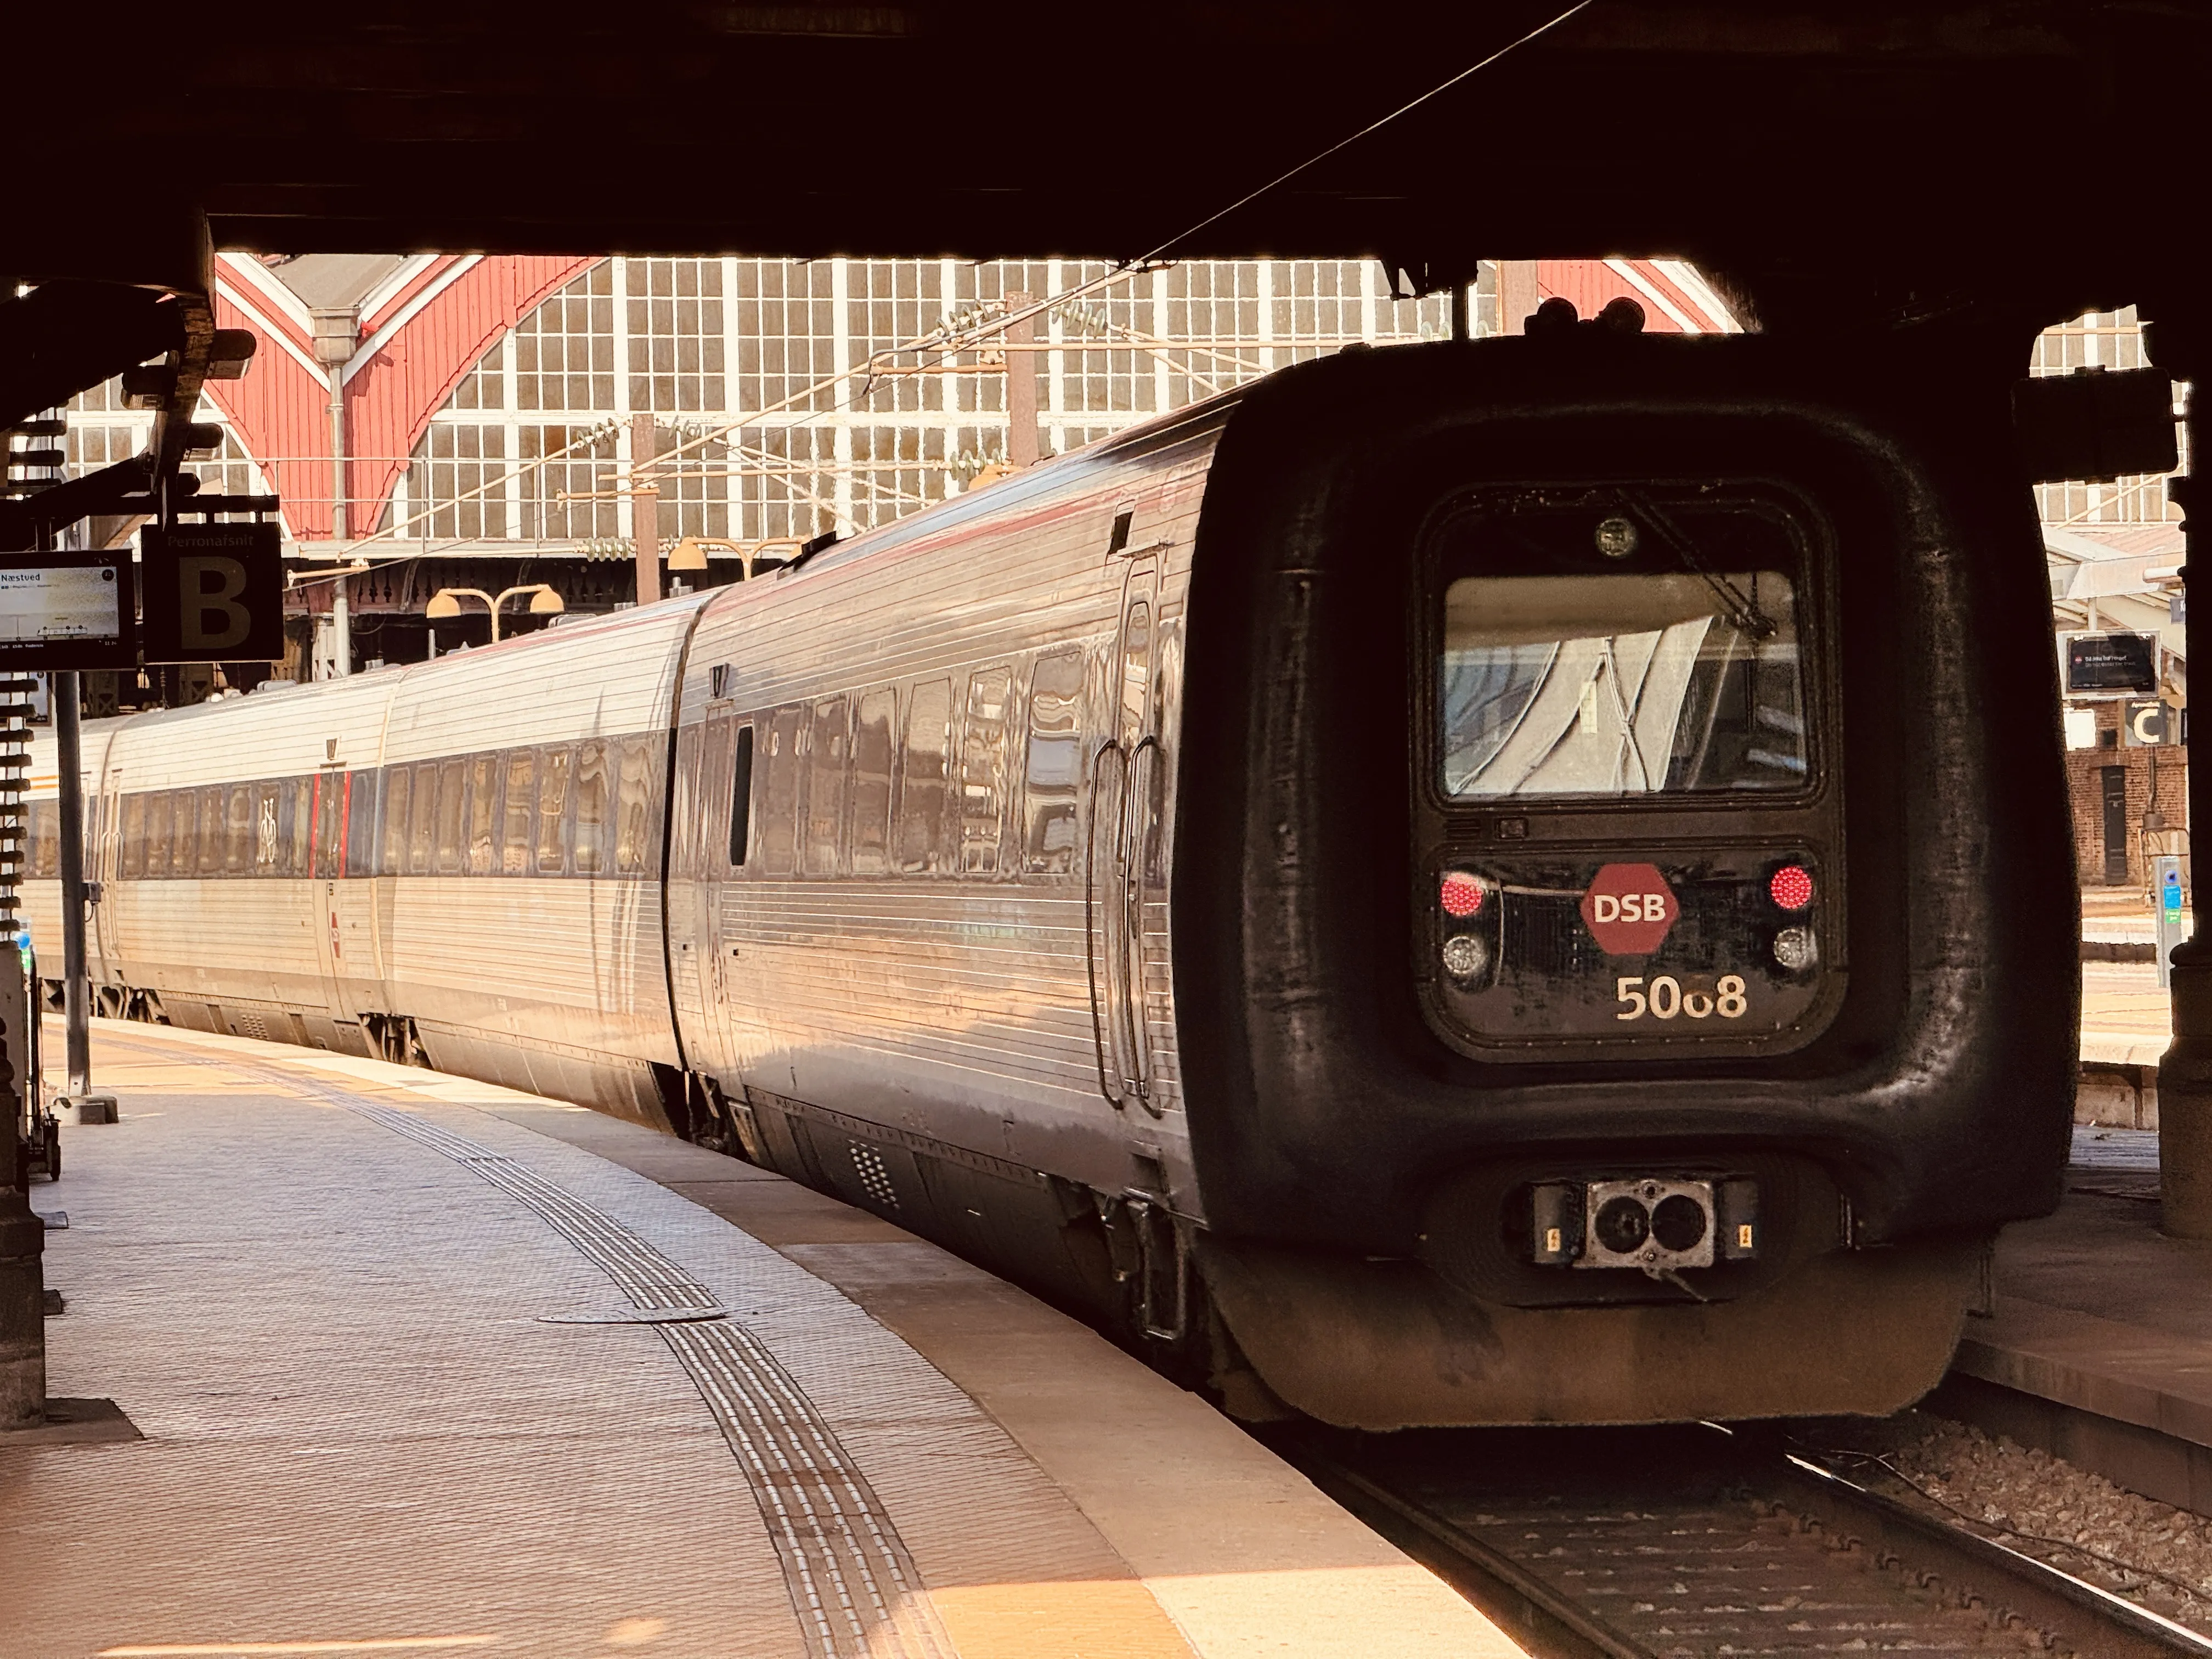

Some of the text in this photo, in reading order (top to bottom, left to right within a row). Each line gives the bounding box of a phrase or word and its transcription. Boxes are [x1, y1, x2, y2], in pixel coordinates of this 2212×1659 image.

[167, 535, 255, 548] Perronafsnit
[179, 556, 251, 650] B
[2134, 708, 2160, 743] C
[1593, 893, 1667, 923] DSB
